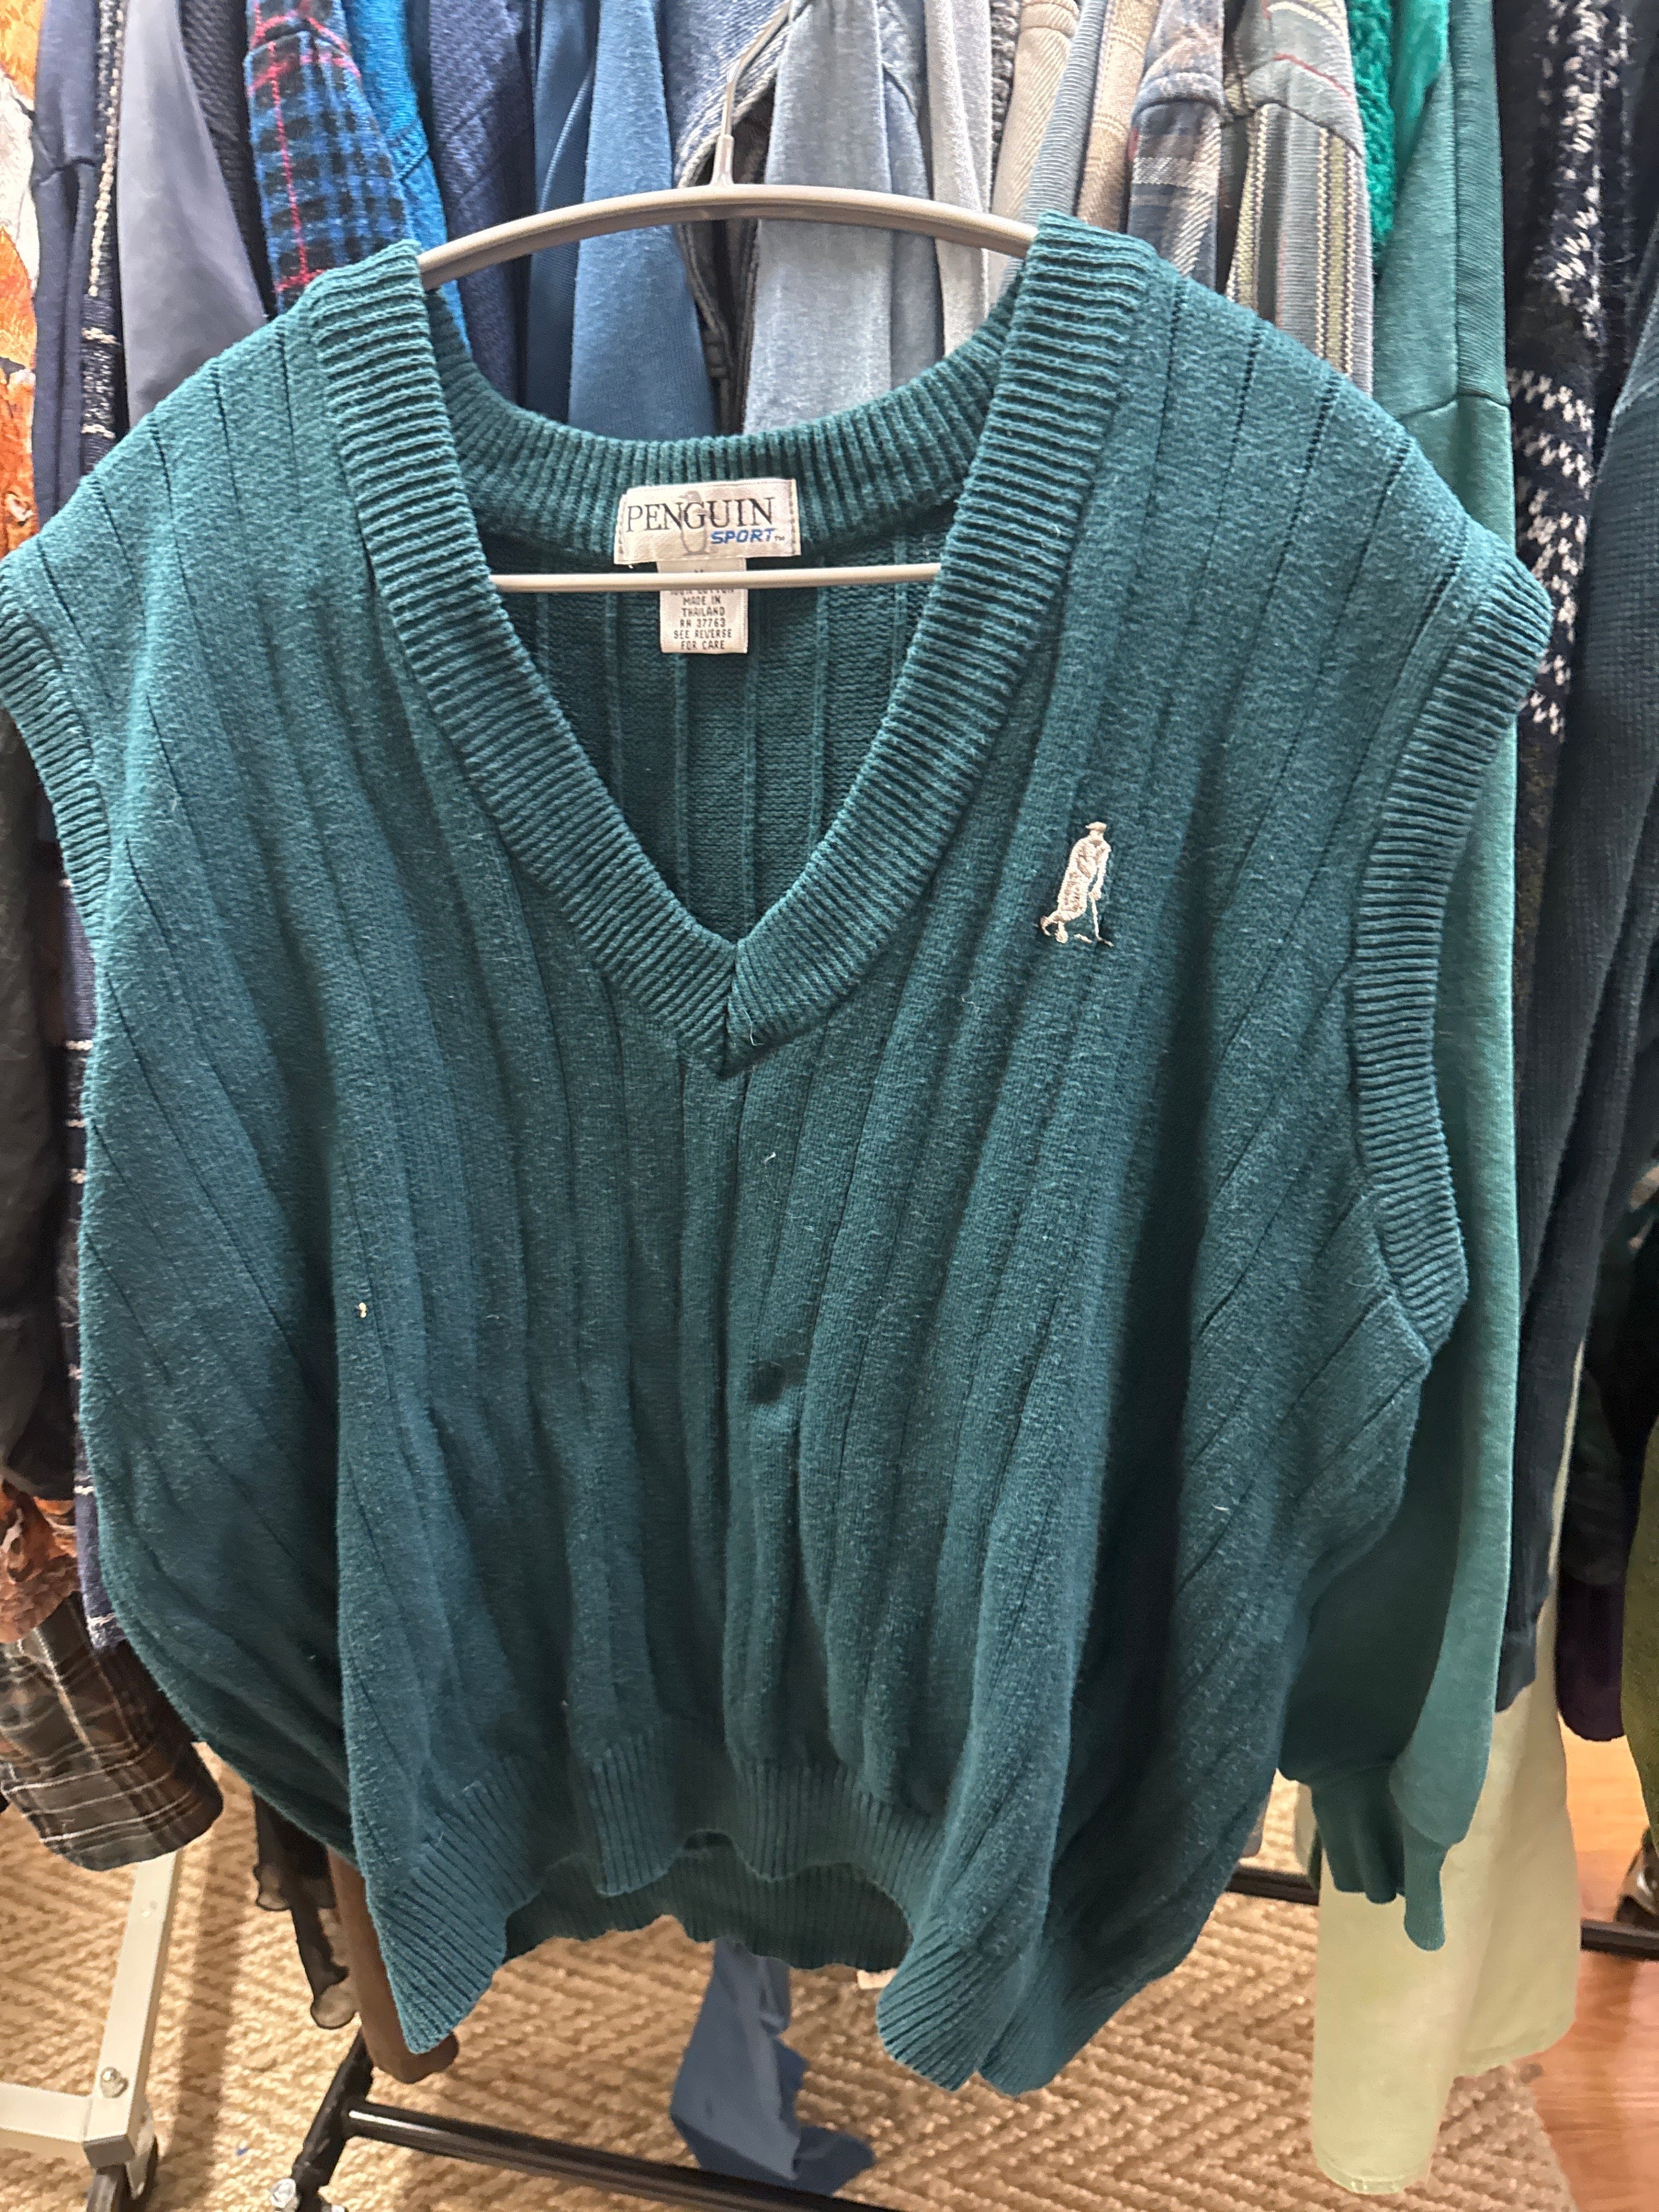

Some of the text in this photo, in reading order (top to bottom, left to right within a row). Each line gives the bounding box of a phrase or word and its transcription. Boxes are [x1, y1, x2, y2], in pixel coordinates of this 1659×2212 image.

[625, 498, 775, 532] PENGUIN
[711, 528, 775, 544] SPORT
[683, 595, 721, 605] MADE IN
[681, 606, 725, 617] THAILAND
[696, 617, 726, 628] 37763
[674, 629, 732, 639] SEE REVERSE
[681, 640, 725, 650] FOR CARE
